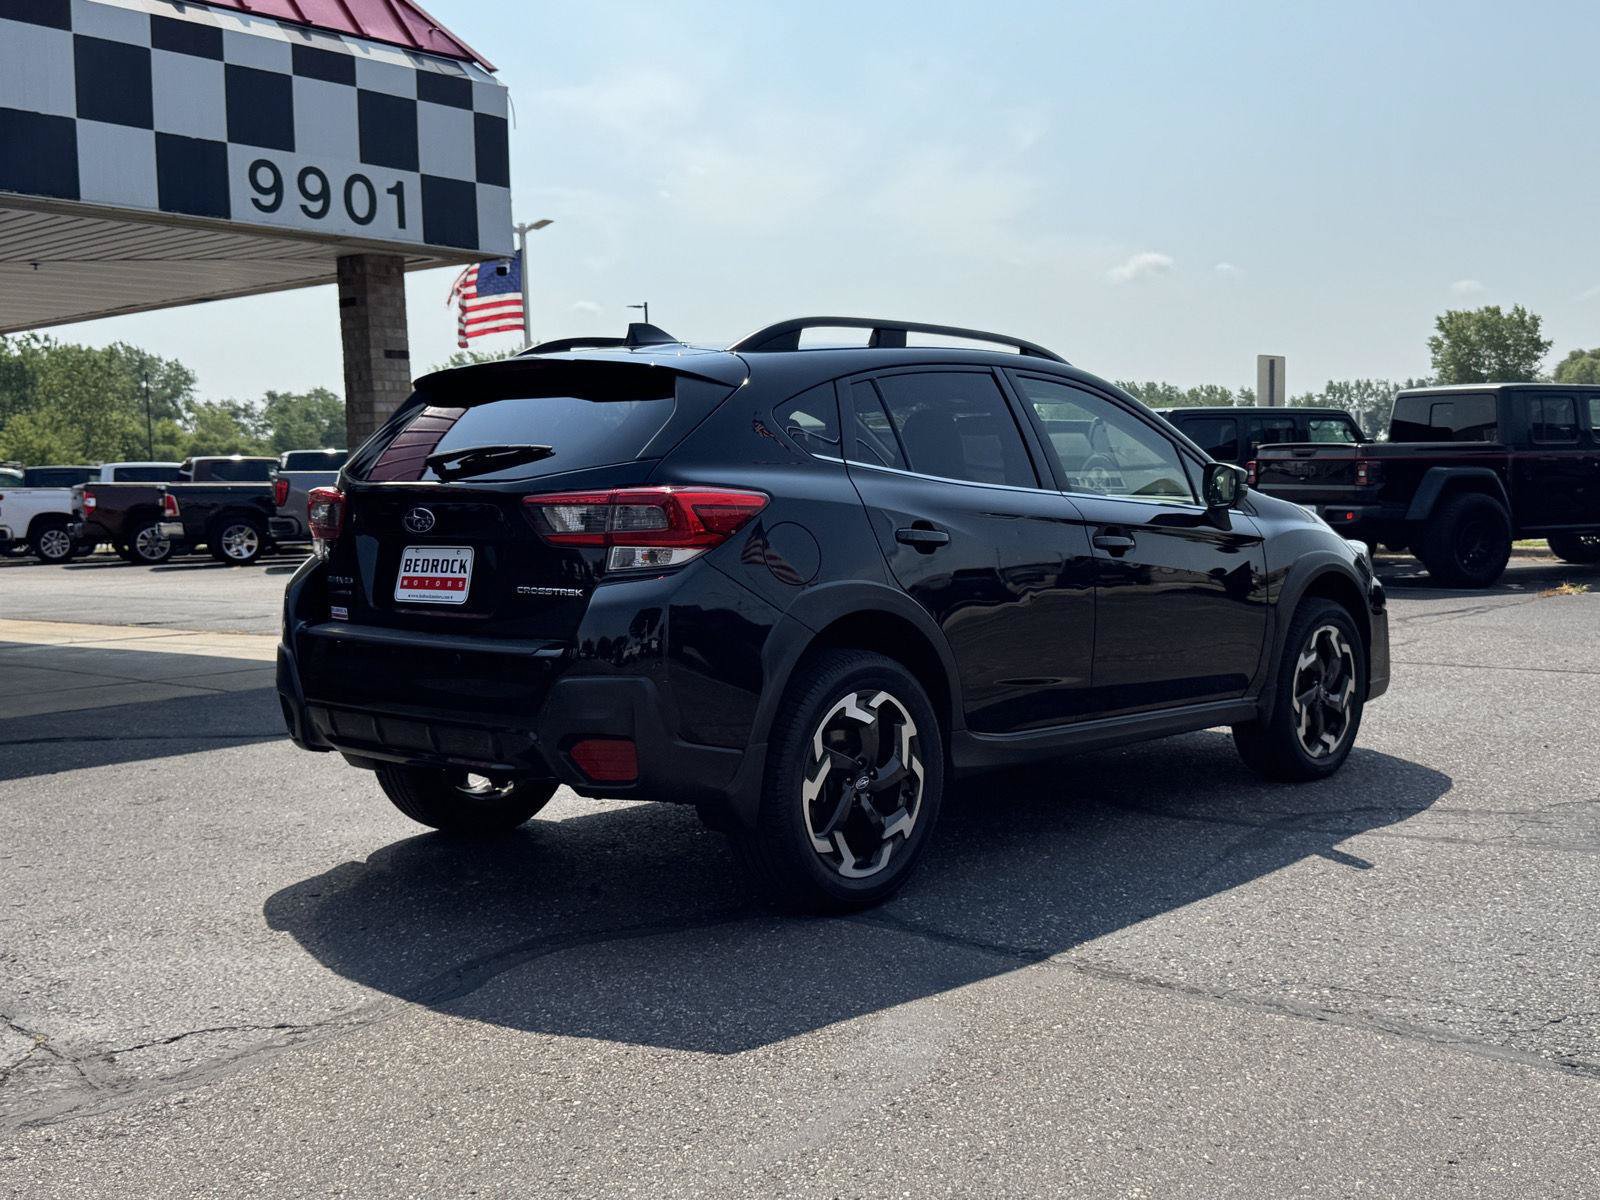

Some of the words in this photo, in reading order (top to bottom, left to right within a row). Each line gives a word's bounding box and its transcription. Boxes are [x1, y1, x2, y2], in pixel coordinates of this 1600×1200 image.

[248, 158, 406, 230] 9901
[403, 558, 468, 574] BEDROCK
[403, 579, 464, 588] MOTORS
[516, 586, 583, 597] CROSSTREK
